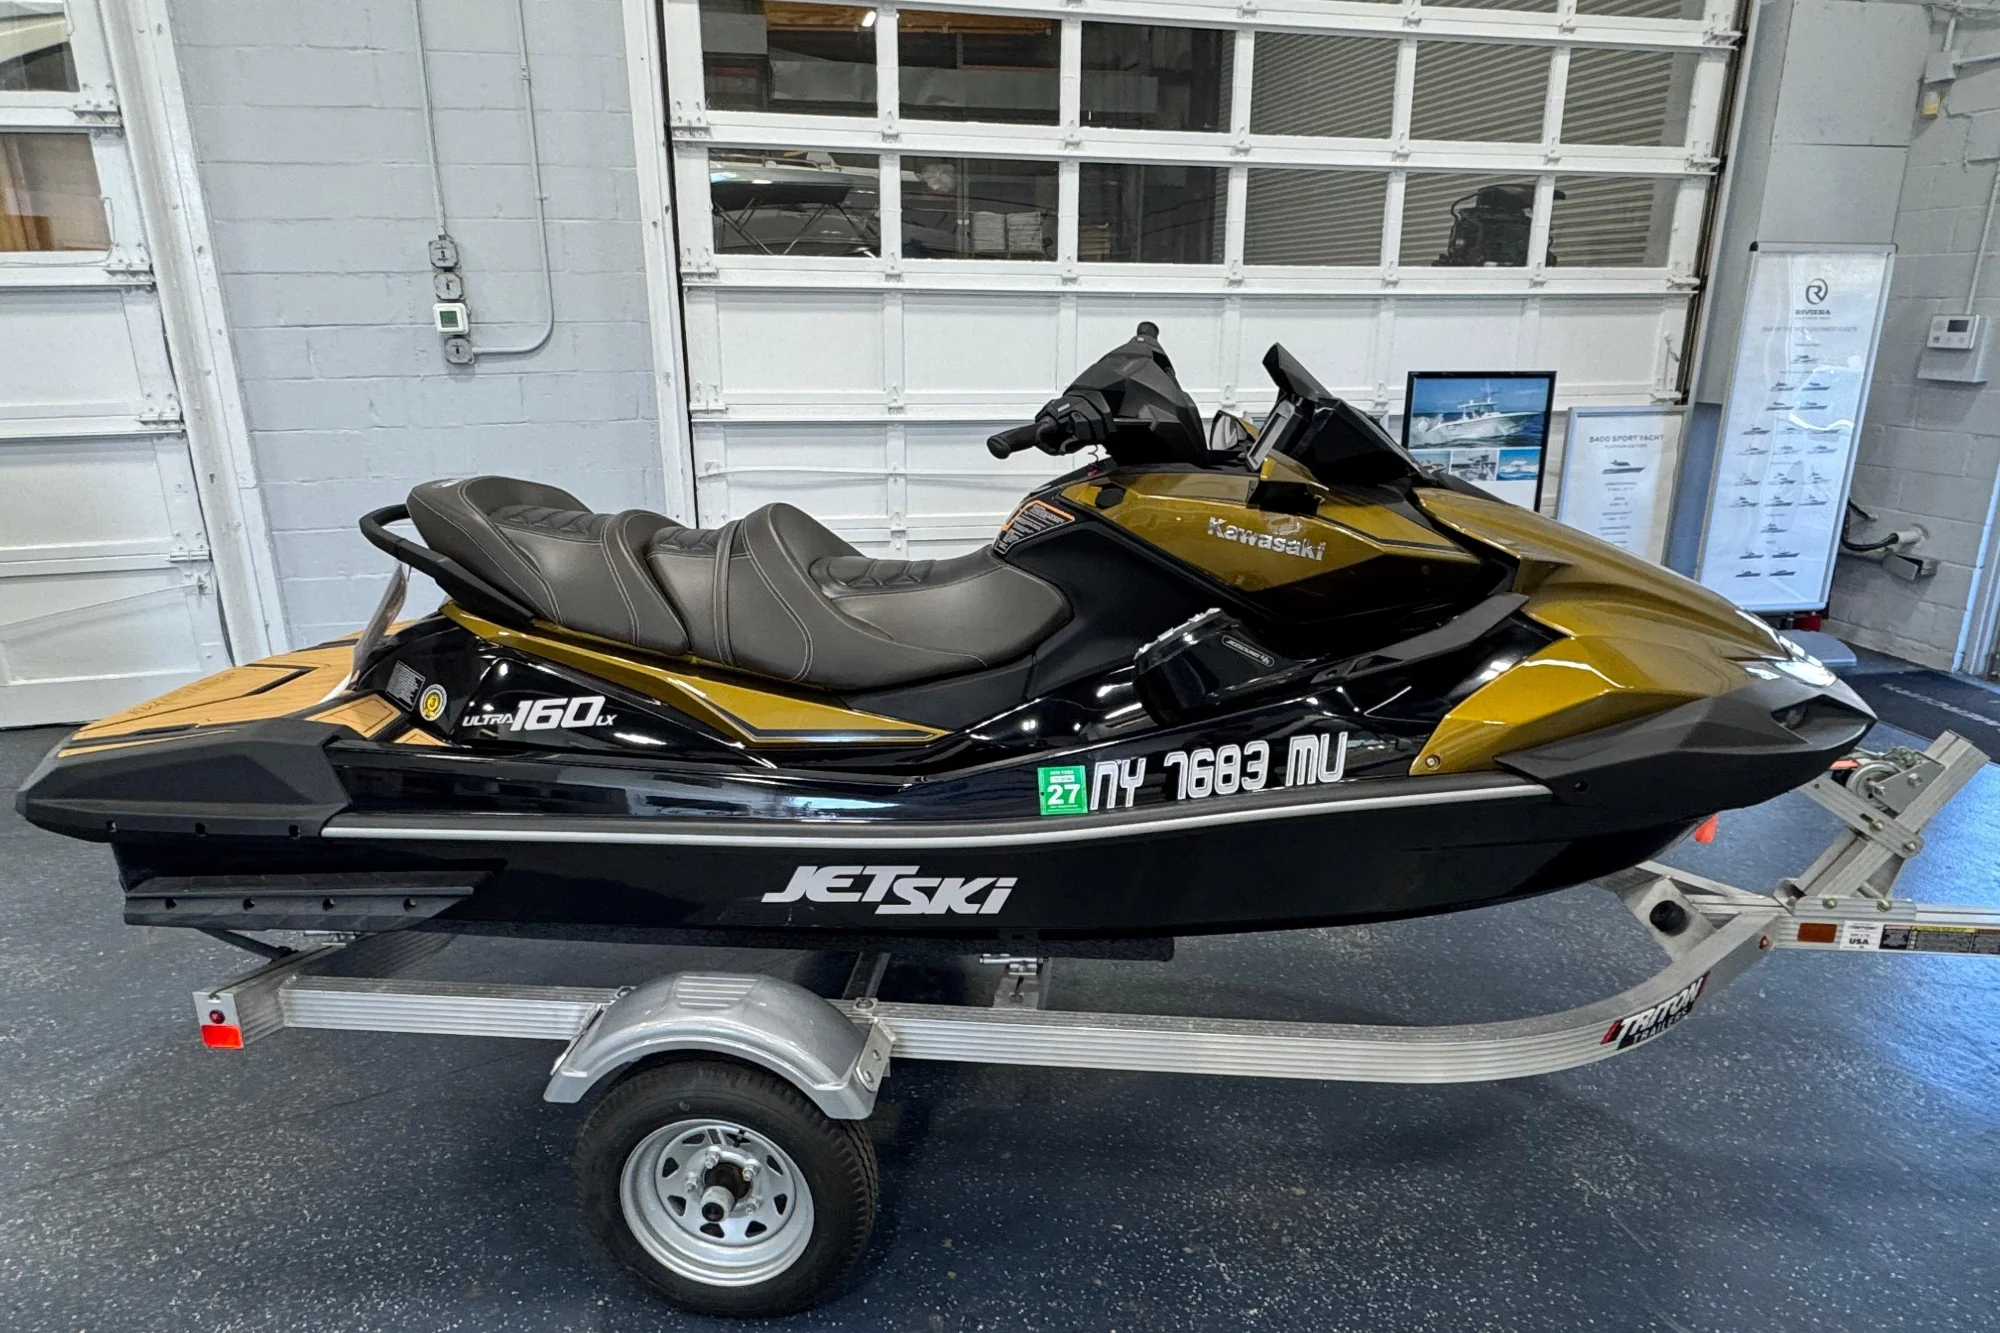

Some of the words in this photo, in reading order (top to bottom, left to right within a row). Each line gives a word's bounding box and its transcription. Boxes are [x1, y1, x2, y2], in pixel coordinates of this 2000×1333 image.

[1612, 434, 1638, 442] SPORT
[1639, 433, 1665, 442] YACHT
[1207, 516, 1327, 561] Kawasaki
[462, 713, 514, 727] ULTRA
[510, 696, 606, 731] 160
[596, 714, 618, 727] LX
[1090, 757, 1147, 811] NY
[1163, 740, 1270, 800] 7683
[1285, 731, 1349, 787] MU
[1047, 783, 1081, 806] 27
[1849, 937, 1870, 946] USA
[1617, 976, 1704, 1044] TRITON
